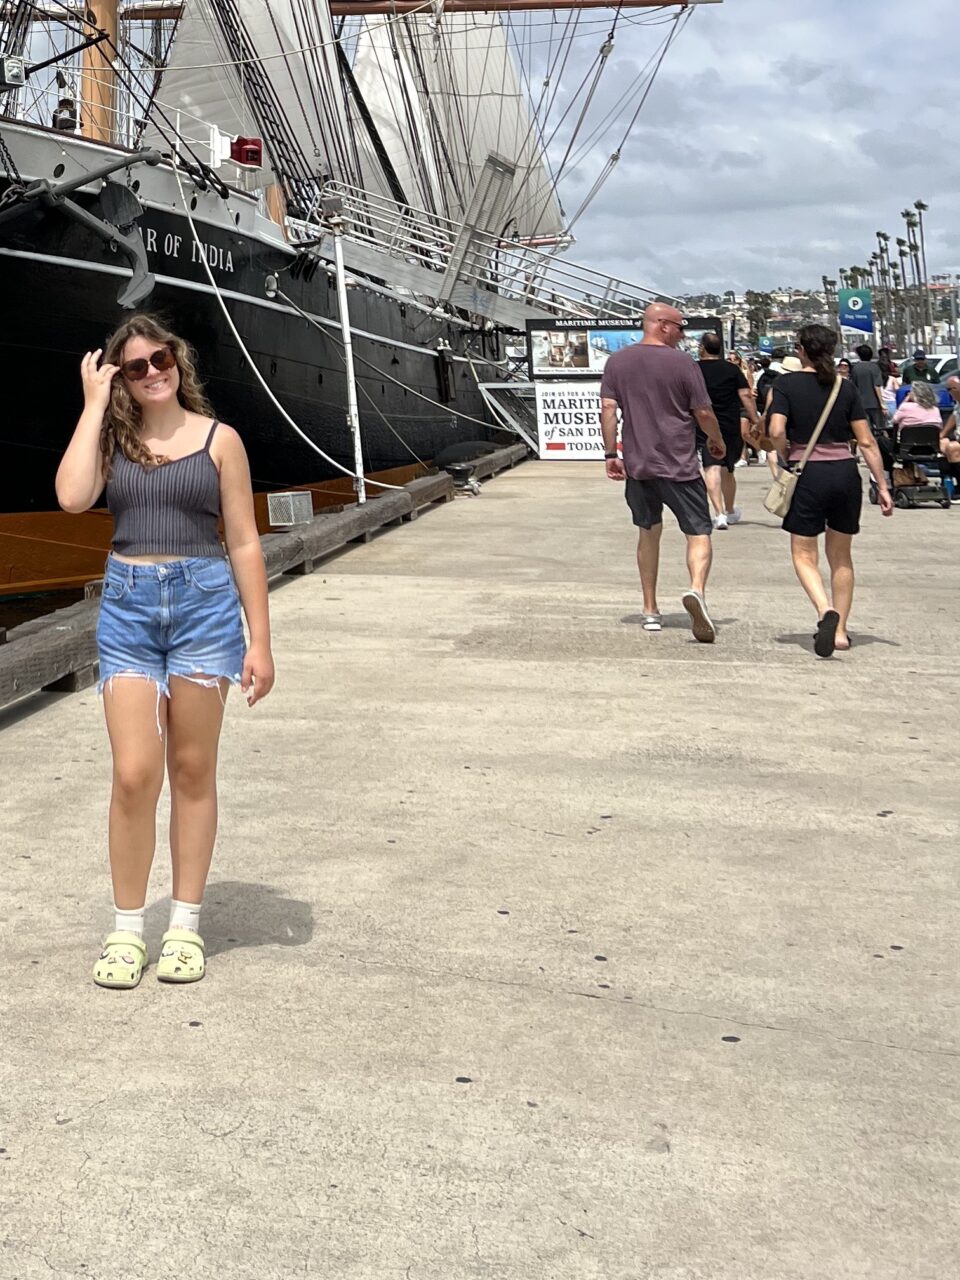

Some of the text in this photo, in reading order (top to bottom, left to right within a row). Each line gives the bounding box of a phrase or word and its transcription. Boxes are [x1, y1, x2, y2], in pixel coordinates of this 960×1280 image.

[164, 233, 182, 258] OF
[191, 240, 234, 273] INDIA
[542, 398, 602, 410] MARITI
[544, 426, 558, 440] of
[558, 427, 583, 437] SAN
